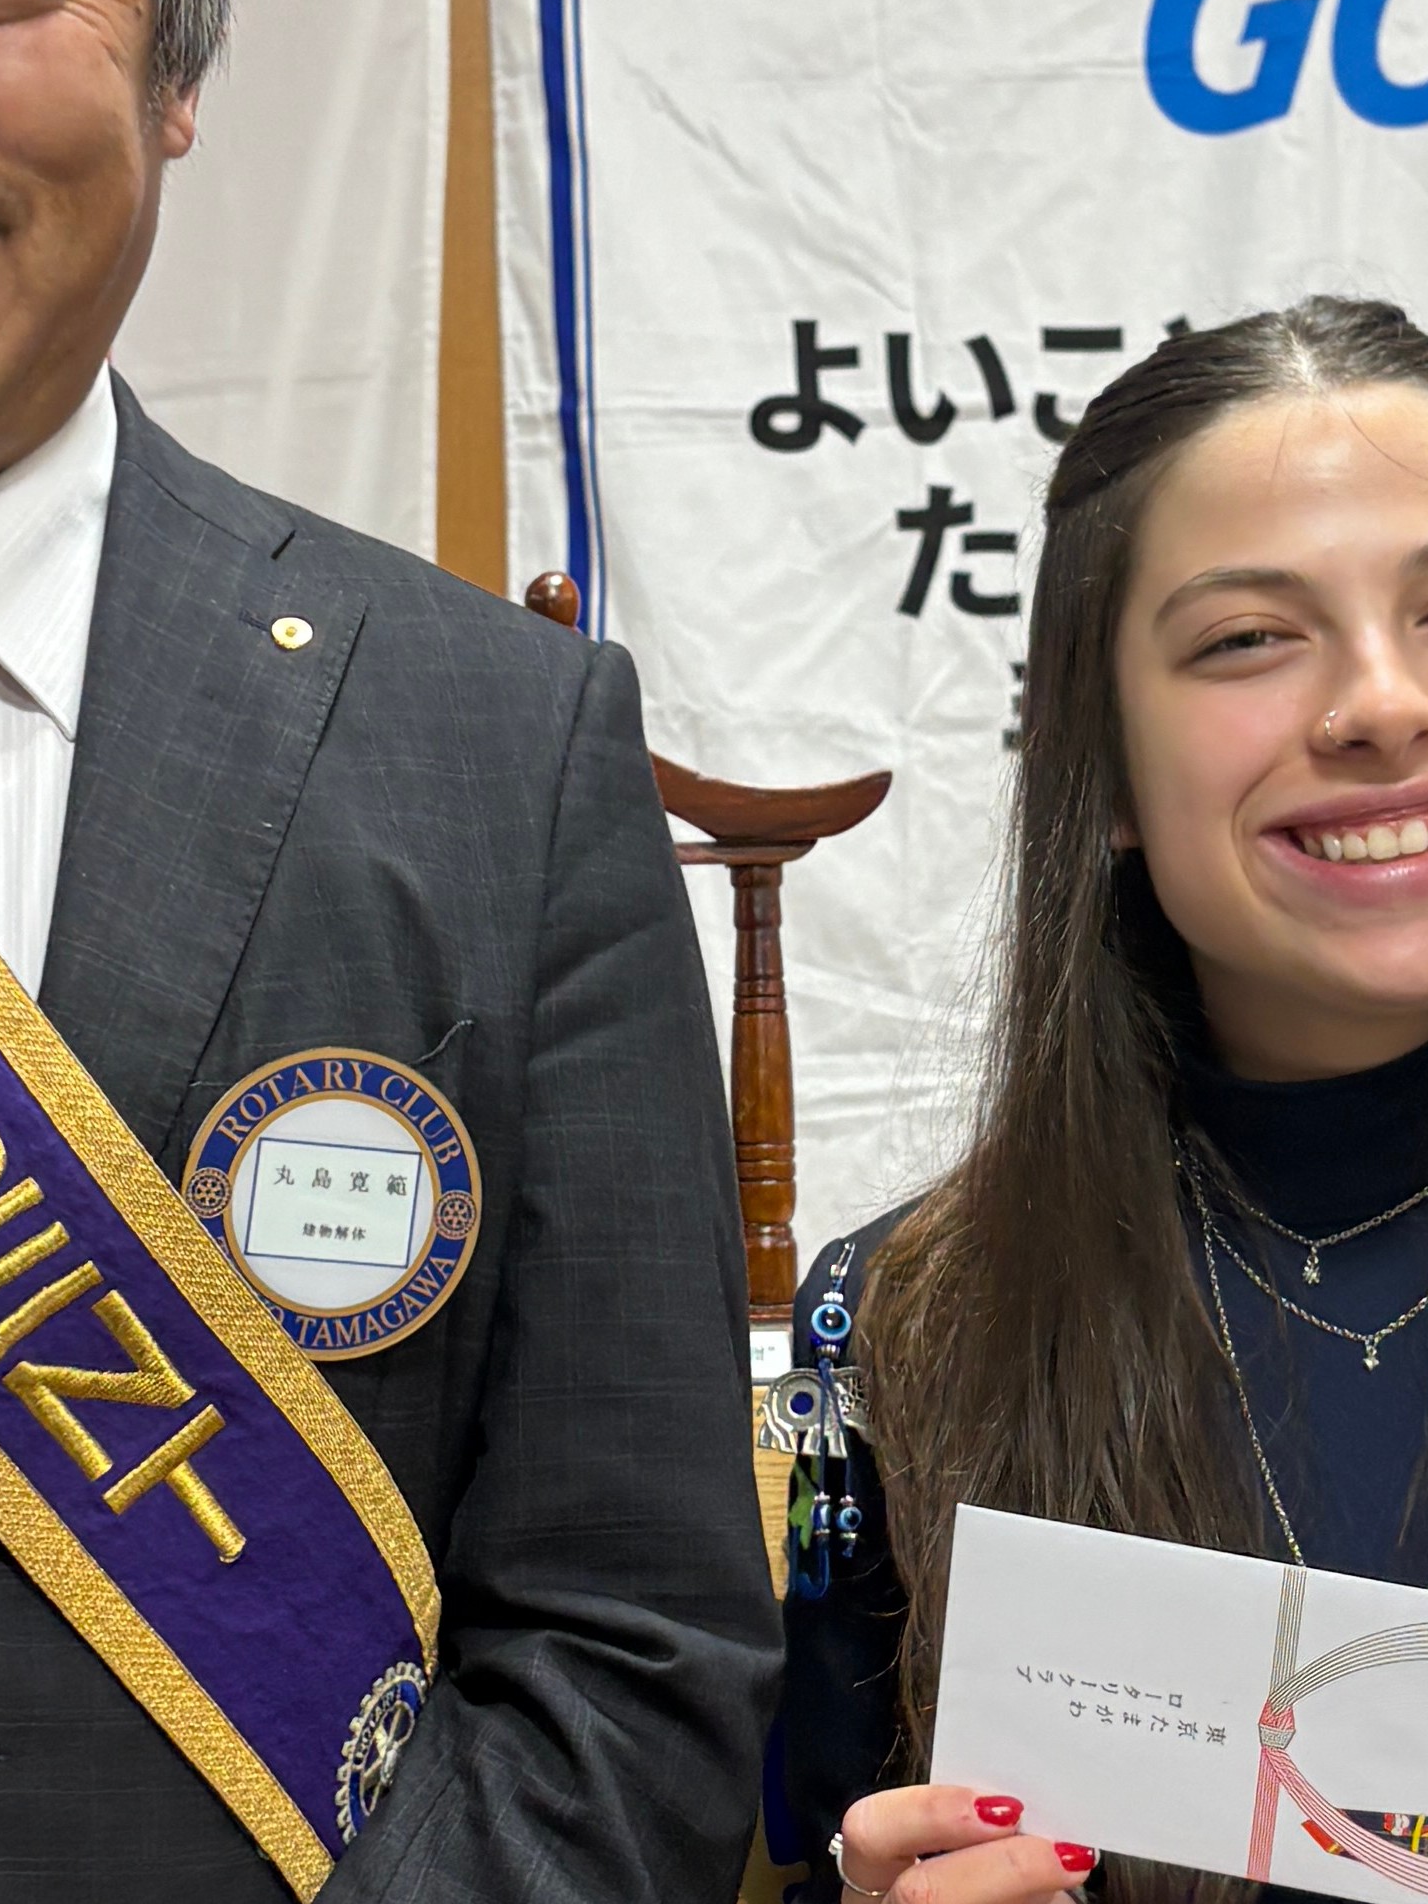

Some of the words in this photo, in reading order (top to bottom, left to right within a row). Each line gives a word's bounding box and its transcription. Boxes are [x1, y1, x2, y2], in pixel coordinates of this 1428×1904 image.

[749, 318, 1192, 453] よいこ
[216, 1060, 373, 1145] ROTARY
[380, 1074, 463, 1165] CLUB
[295, 1255, 457, 1347] TAMAGAWA
[1069, 1700, 1227, 1746] 東京たまがわ
